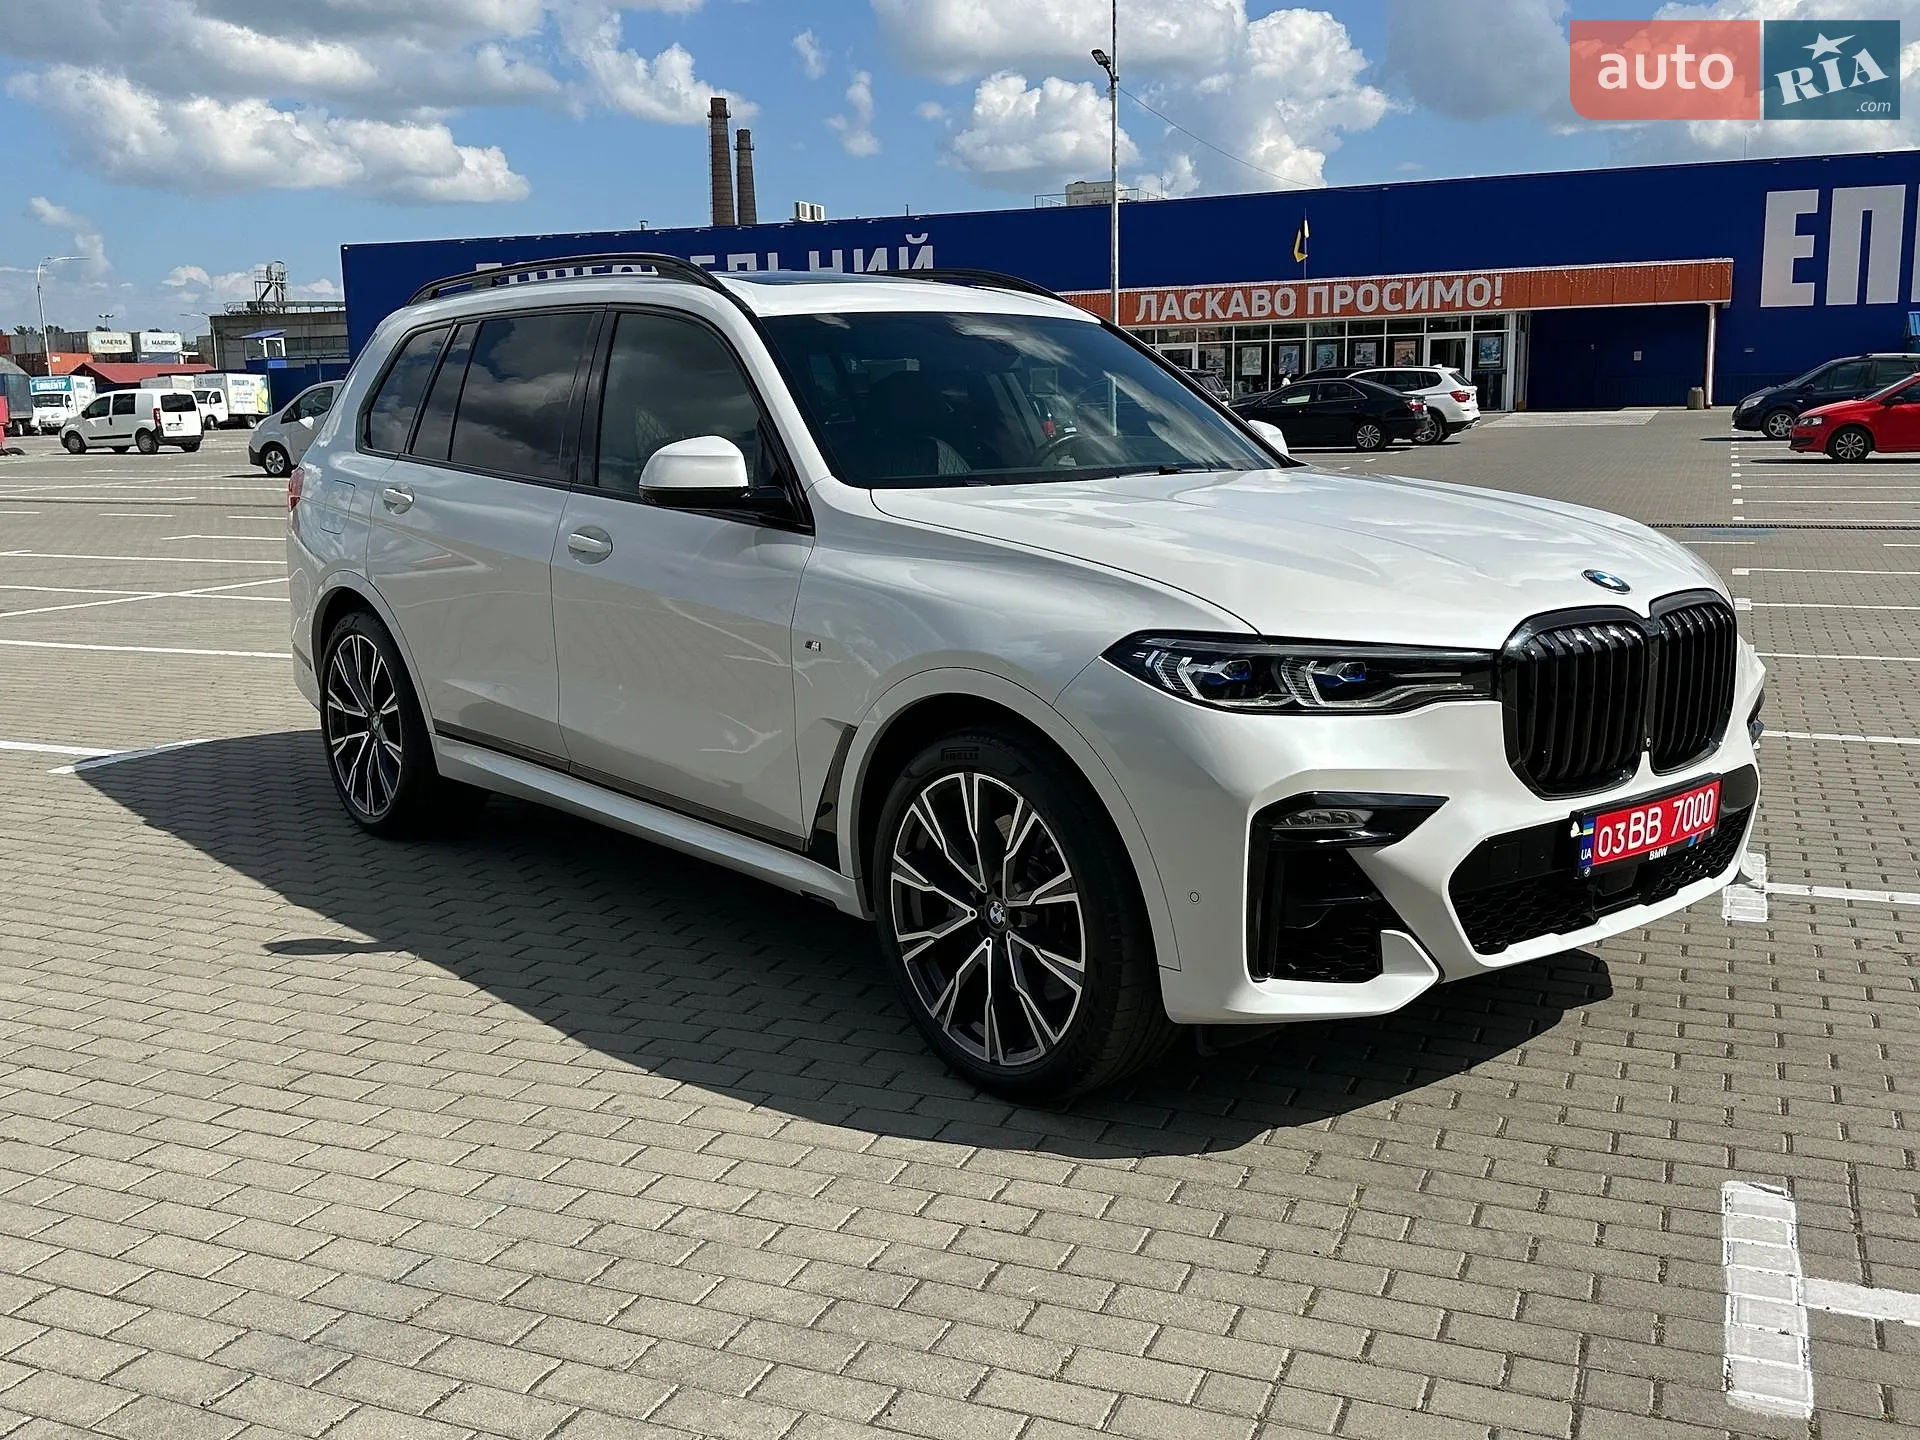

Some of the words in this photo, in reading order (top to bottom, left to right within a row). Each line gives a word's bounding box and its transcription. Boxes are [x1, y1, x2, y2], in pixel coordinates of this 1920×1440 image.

[1136, 287, 1298, 322] ЛАСКАВО
[1307, 276, 1503, 314] ПРОСИМО!
[1598, 807, 1663, 858] 03BB
[1671, 788, 1715, 838] 7000
[1580, 848, 1592, 861] UA
[1649, 847, 1669, 861] BMW
